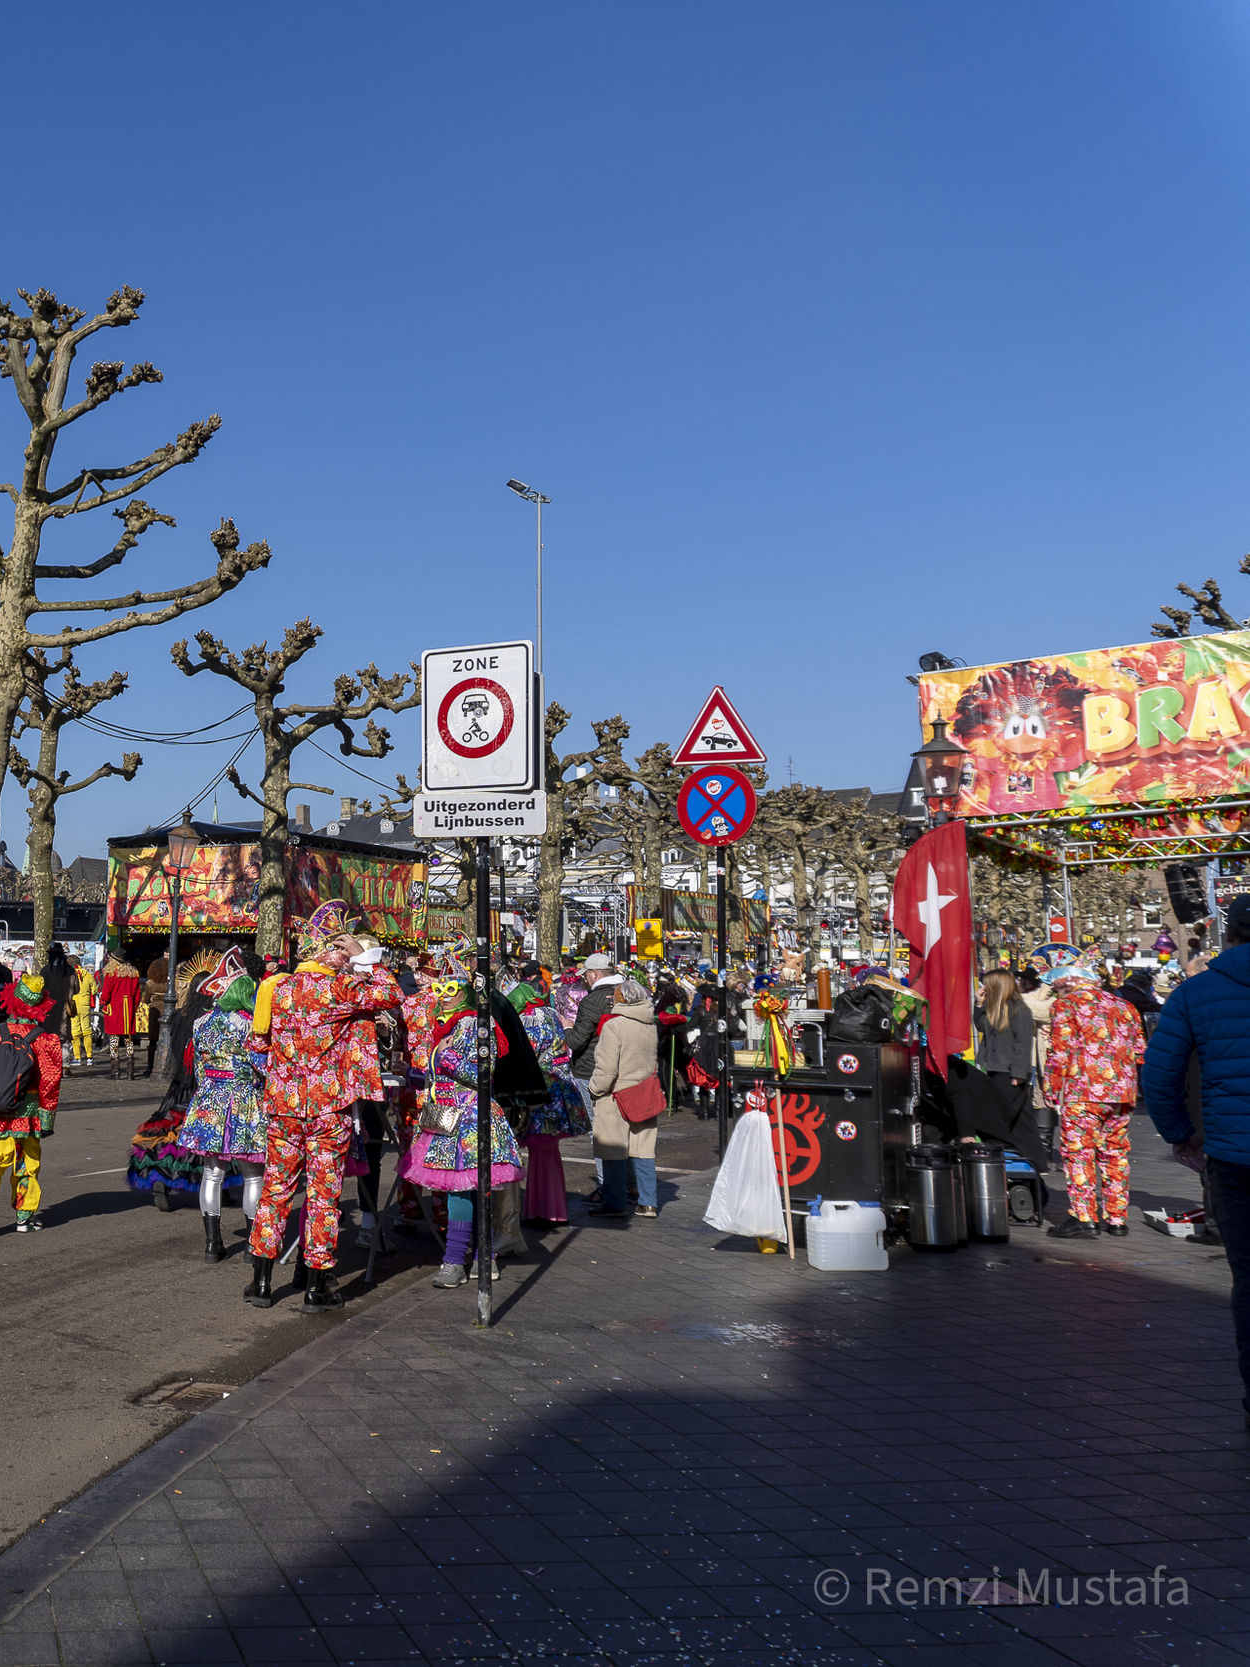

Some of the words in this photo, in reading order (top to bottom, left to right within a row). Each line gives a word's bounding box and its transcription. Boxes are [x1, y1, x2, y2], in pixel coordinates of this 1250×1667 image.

[453, 656, 499, 672] ZONE
[1083, 680, 1250, 751] BRA
[424, 798, 536, 815] Uitgezonderd
[434, 815, 525, 830] Lijnbussen
[318, 873, 405, 910] BRASILICA
